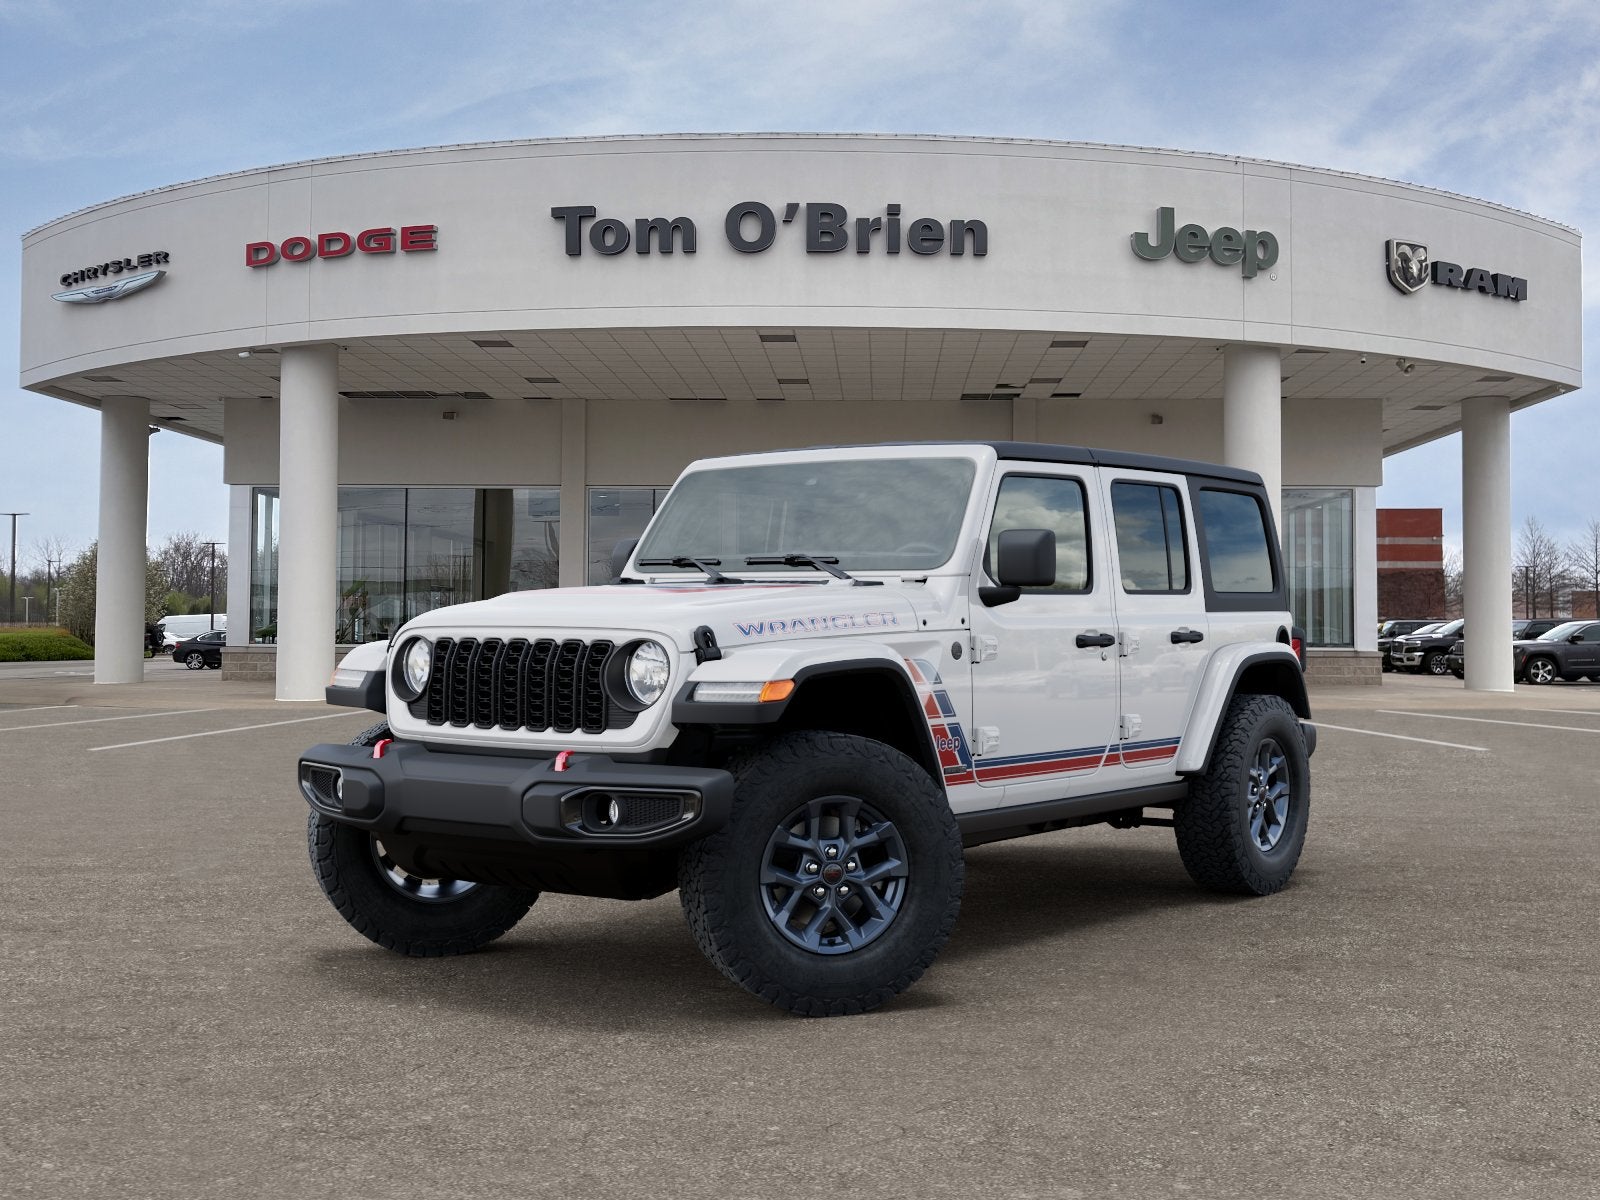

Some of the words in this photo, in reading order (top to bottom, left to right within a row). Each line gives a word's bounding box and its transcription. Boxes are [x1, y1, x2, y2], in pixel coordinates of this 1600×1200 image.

[246, 224, 438, 268] DODGE
[551, 205, 697, 257] Tom
[725, 201, 988, 257] O'Brien
[1130, 206, 1279, 278] Jeep
[60, 250, 170, 287] CHRYSLER
[1431, 260, 1527, 301] RAM
[733, 611, 899, 637] WRANGLER
